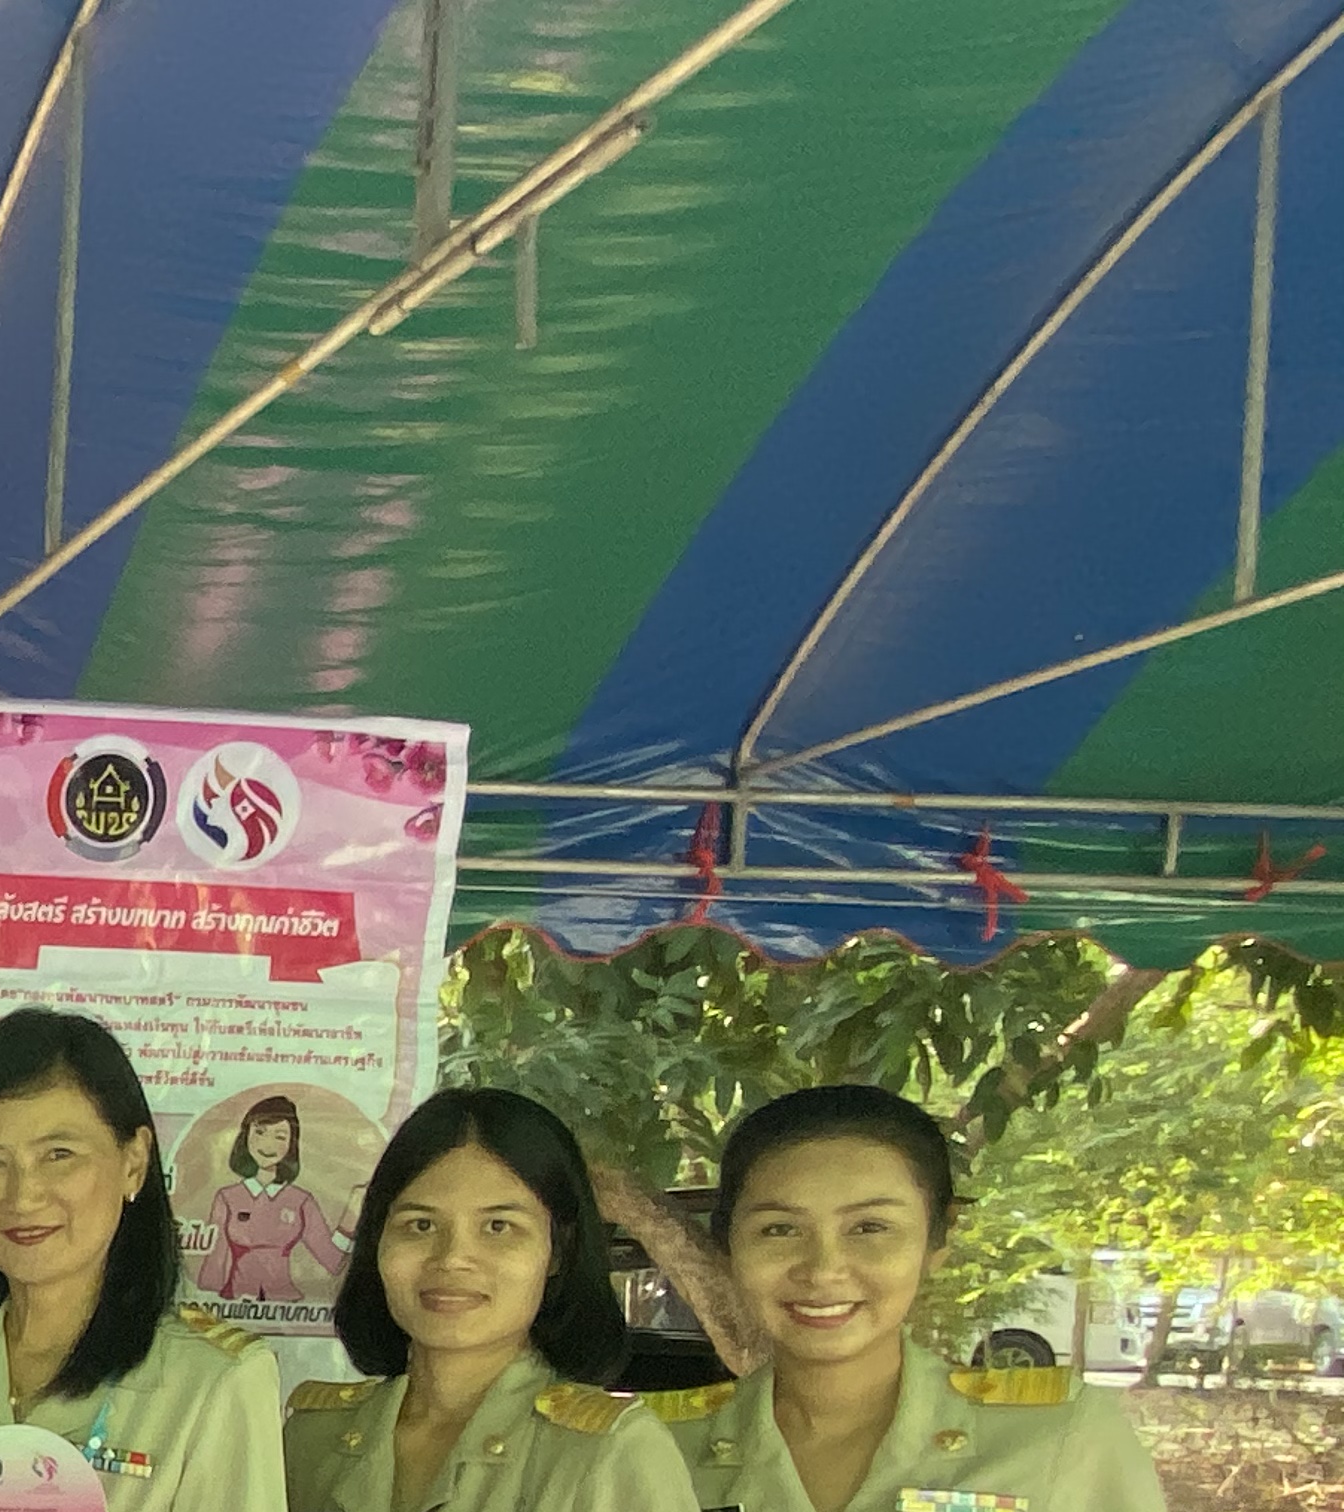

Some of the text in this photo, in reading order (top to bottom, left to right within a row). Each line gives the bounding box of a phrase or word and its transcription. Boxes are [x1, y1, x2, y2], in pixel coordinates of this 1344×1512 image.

[71, 899, 186, 928] สร้างบทบาท
[192, 904, 340, 941] สร้างคุณค่าชีวิต
